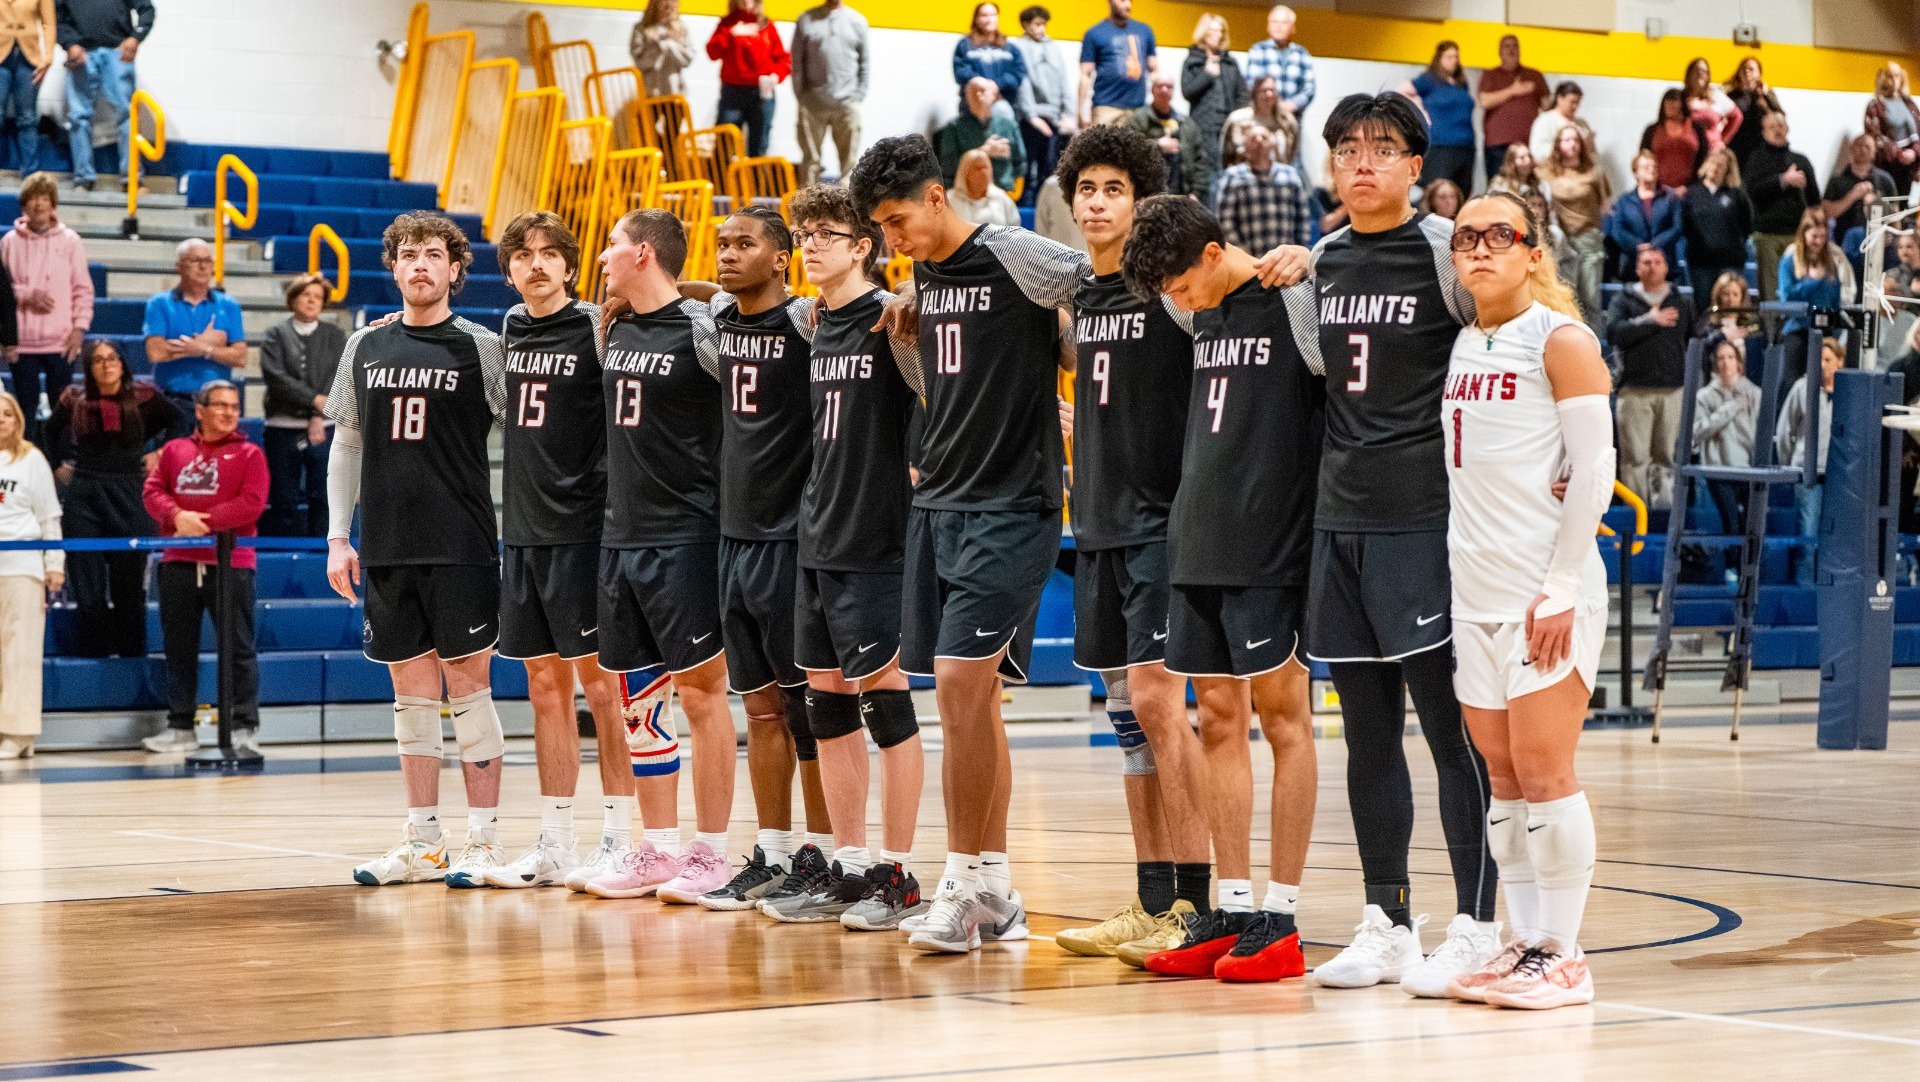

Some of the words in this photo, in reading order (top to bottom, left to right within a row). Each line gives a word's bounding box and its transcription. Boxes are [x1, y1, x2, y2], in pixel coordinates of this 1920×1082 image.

[920, 286, 992, 315] VALIANTS
[1320, 294, 1418, 325] VALIANTS
[505, 350, 578, 376] VALIANTS
[603, 349, 675, 376] VALIANTS
[718, 331, 786, 359] VALIANTS
[934, 322, 962, 375] 10
[1346, 332, 1370, 393] 3
[366, 367, 460, 392] VALIANTS
[731, 363, 758, 414] 12
[1092, 351, 1111, 406] 9
[1443, 372, 1518, 401] LIANTS
[390, 395, 428, 441] 18
[517, 381, 549, 428] 15
[614, 378, 642, 428] 13
[822, 389, 842, 441] 11
[1207, 376, 1229, 434] 4
[1452, 408, 1462, 468] 1
